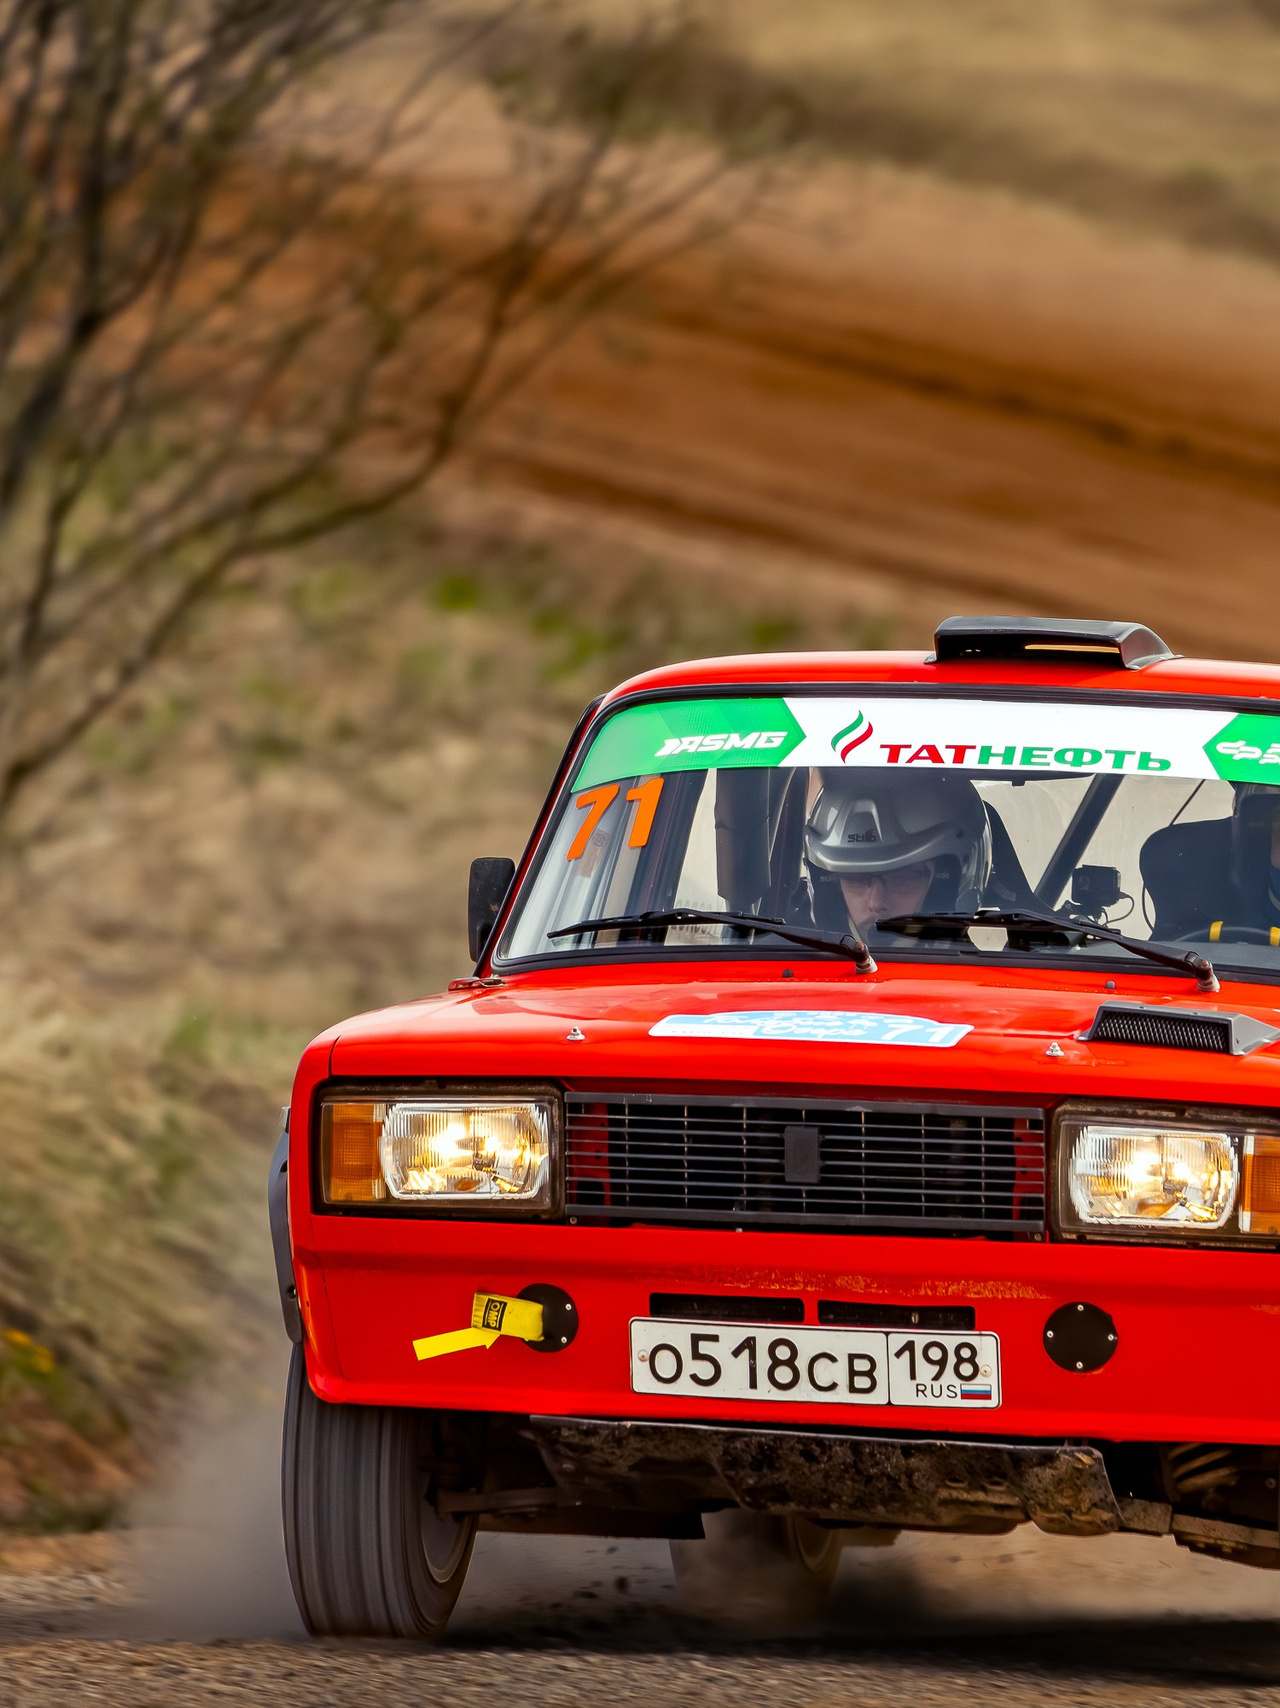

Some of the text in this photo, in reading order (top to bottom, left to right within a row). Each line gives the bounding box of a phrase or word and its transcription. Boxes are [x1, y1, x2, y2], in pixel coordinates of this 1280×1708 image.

[669, 731, 788, 755] ASMG
[880, 744, 1171, 771] ТАТНЕФТЬ
[566, 777, 664, 861] 71
[880, 1024, 950, 1043] 71
[487, 1302, 501, 1328] OMP
[893, 1339, 980, 1383] 198
[916, 1383, 958, 1399] RUS
